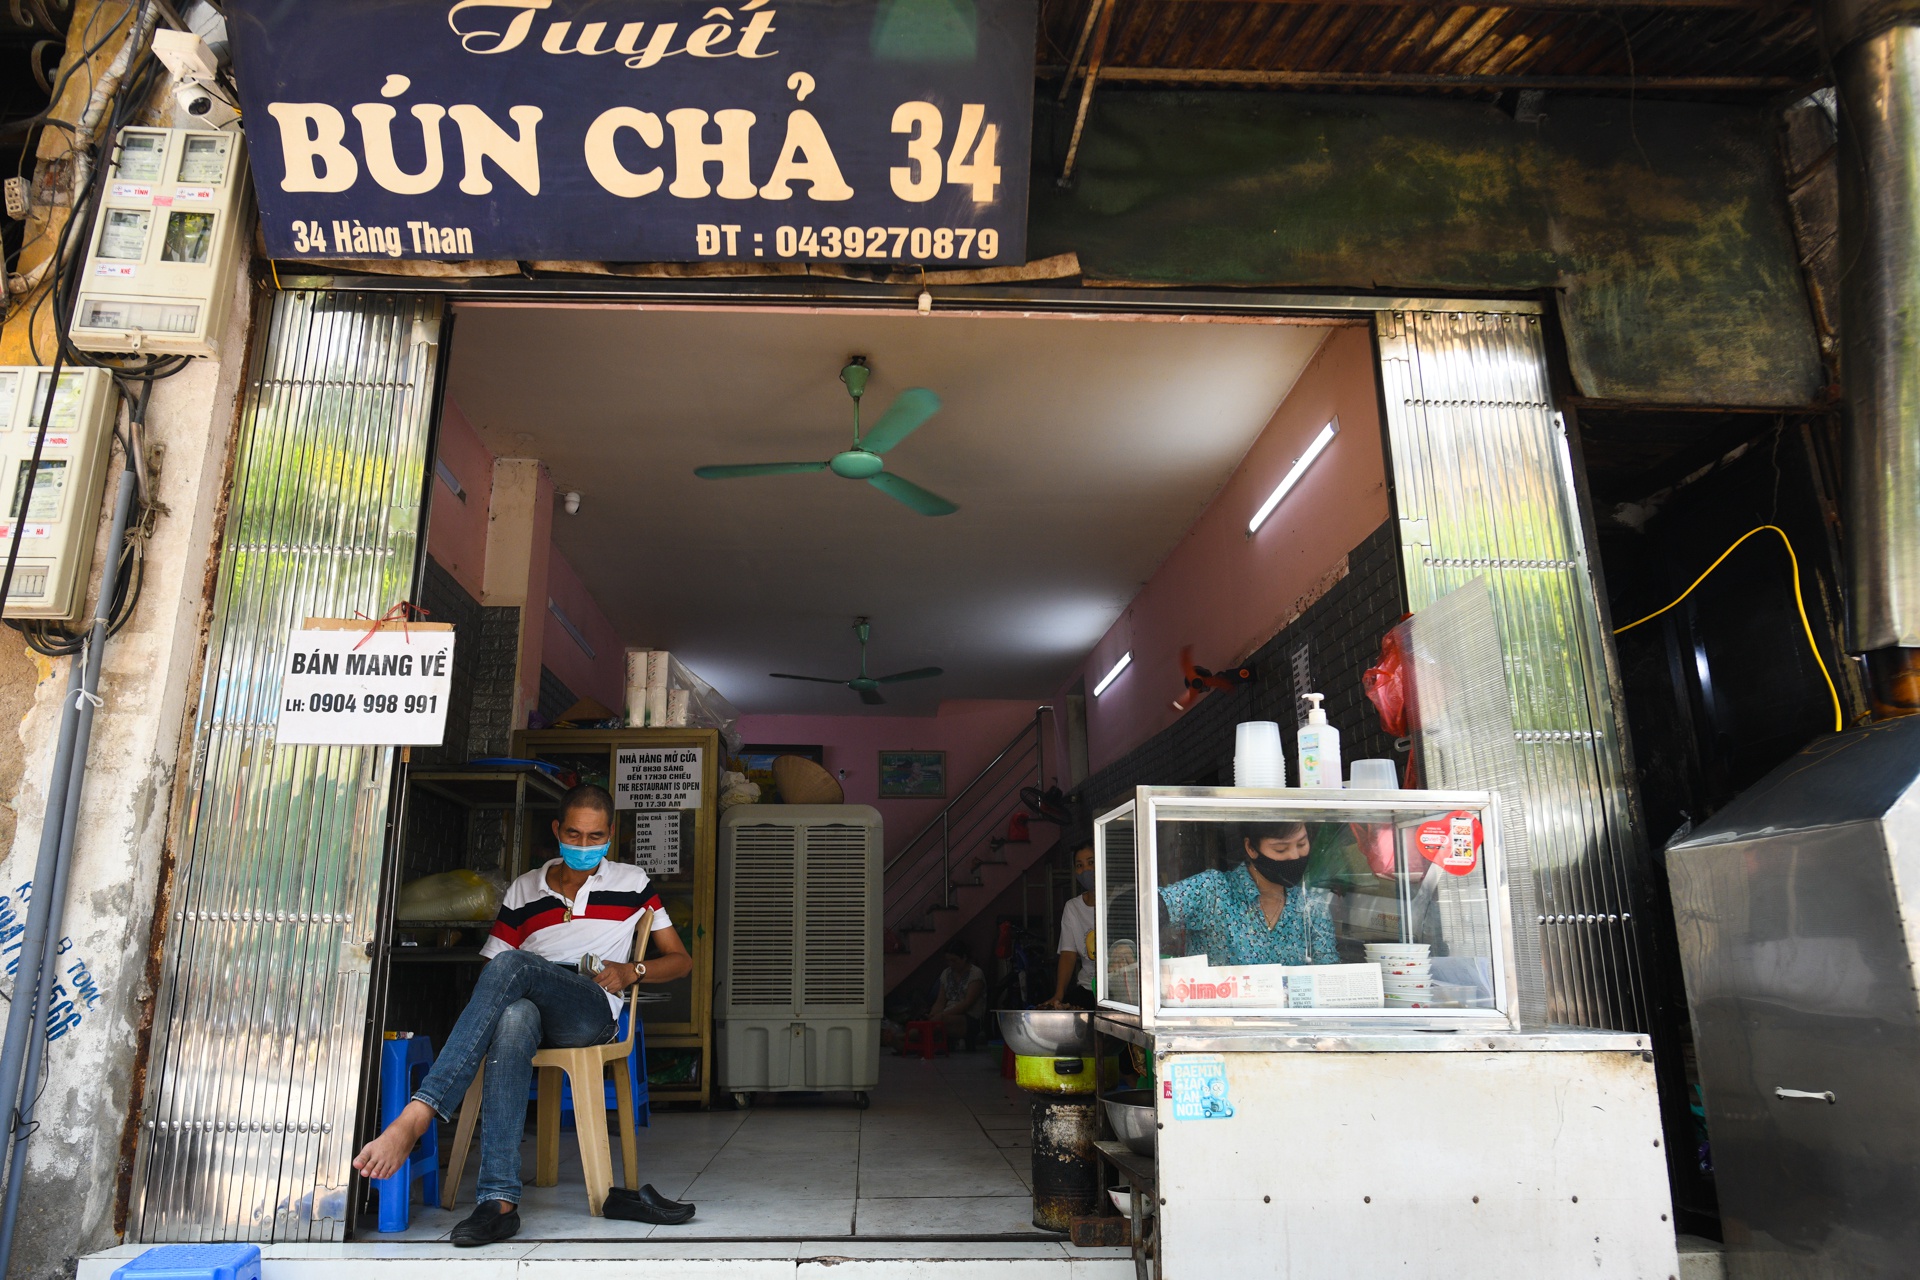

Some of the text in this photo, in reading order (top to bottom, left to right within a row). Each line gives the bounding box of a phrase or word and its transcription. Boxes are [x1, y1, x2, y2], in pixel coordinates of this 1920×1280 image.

[448, 0, 779, 69] Tuyết
[267, 71, 1001, 202] BÚN CHẢ 34
[292, 219, 474, 258] 34 Hàng Than
[696, 224, 741, 256] ĐT
[775, 225, 999, 259] 0439270879
[291, 647, 448, 677] BÁN MANG VỀ
[285, 693, 438, 714] LH: 0904 998 991
[619, 750, 697, 764] NHÀ HÀNG MỞ CỬA
[618, 781, 700, 792] THE RESTAURANT IS OPEN
[629, 793, 654, 801] FROM:
[1174, 1064, 1223, 1078] BAEMIN
